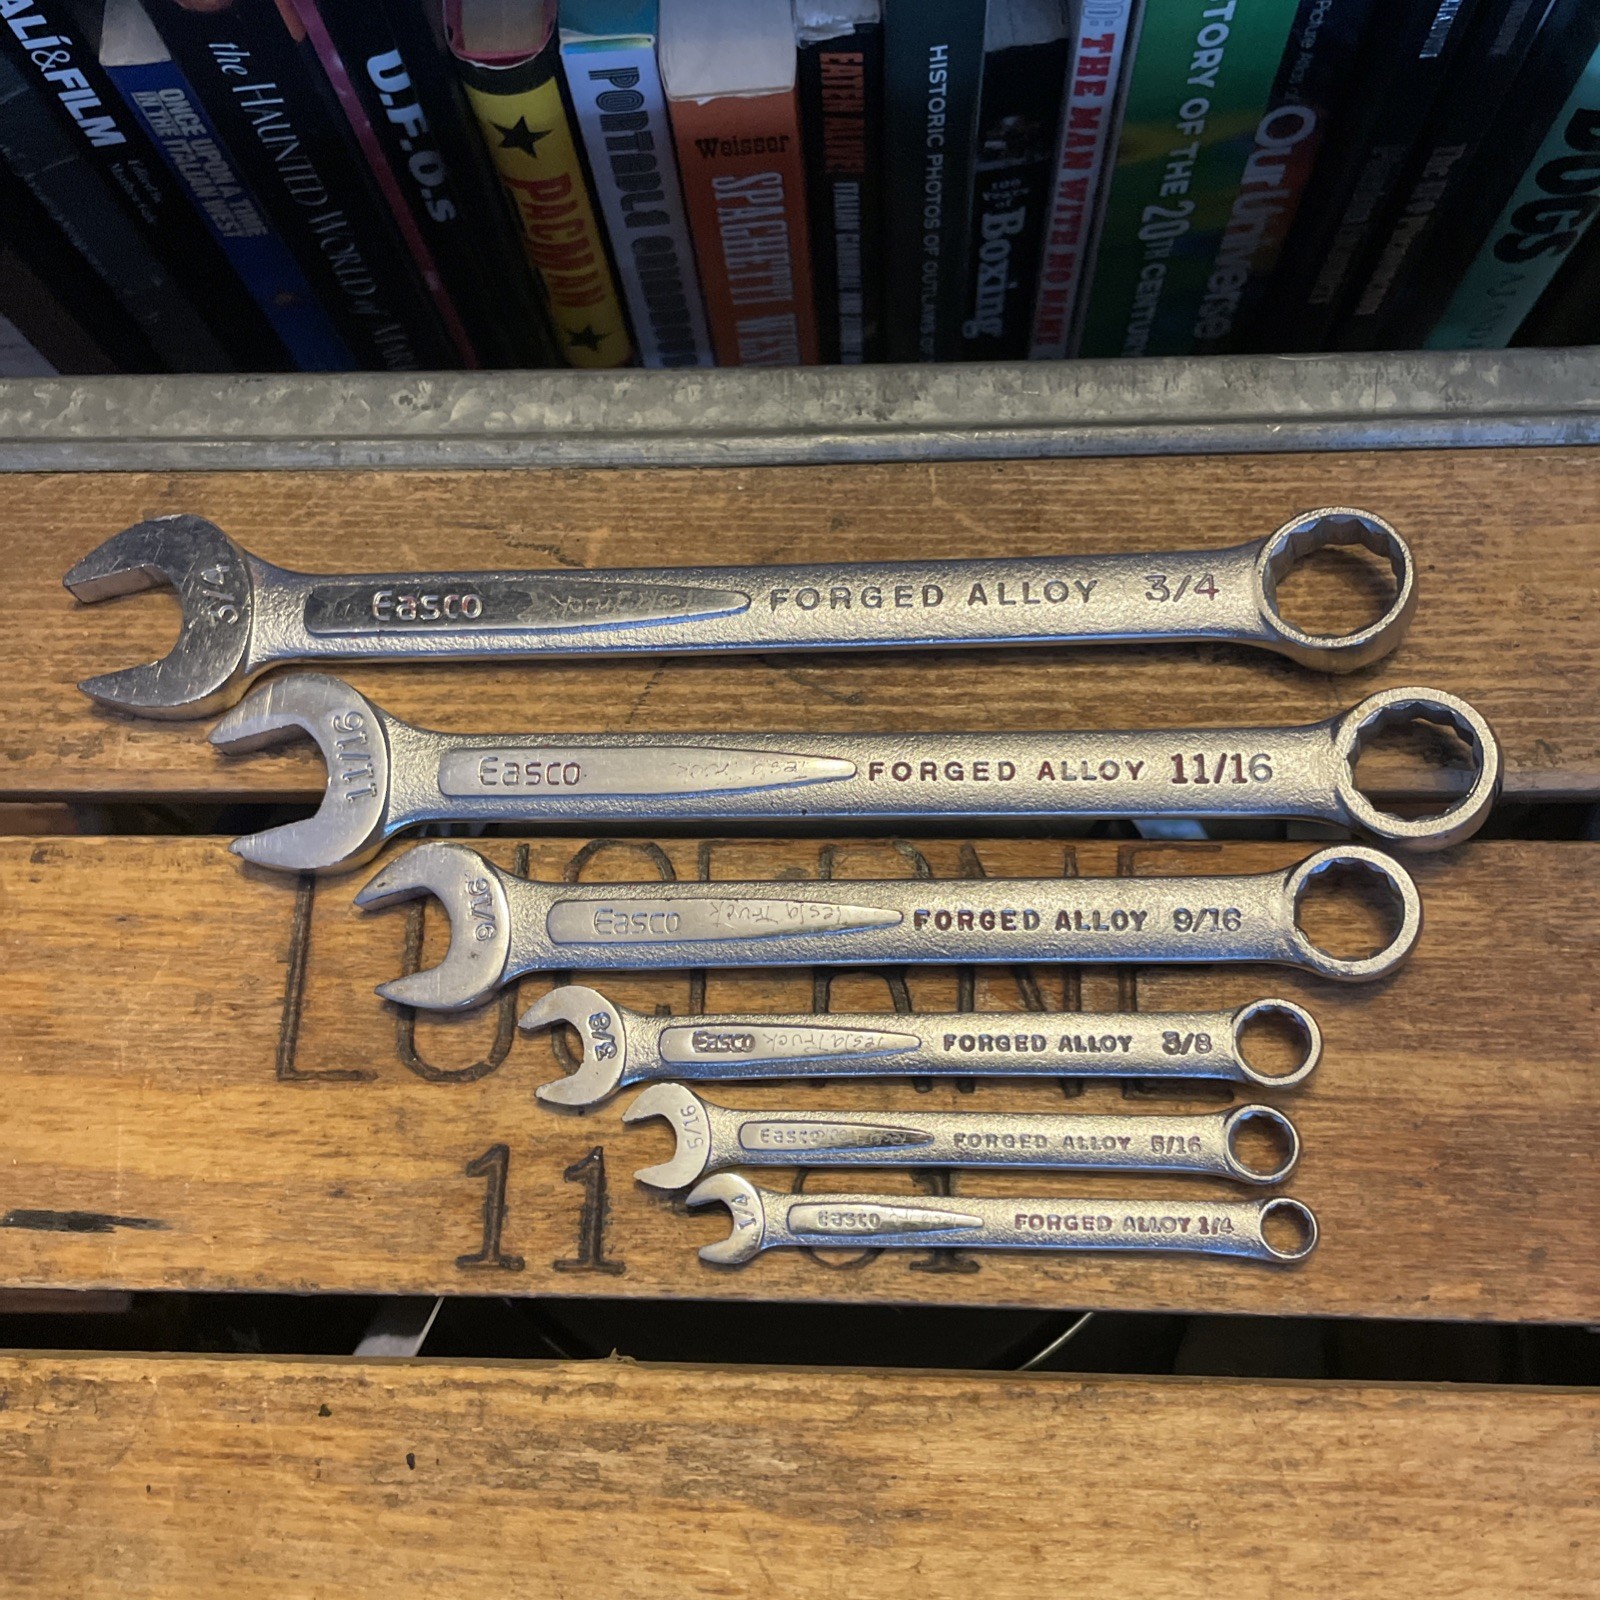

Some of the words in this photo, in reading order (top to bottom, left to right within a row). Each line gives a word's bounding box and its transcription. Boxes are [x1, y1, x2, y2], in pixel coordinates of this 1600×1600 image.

[1077, 33, 1116, 97] THE
[1186, 0, 1238, 89] TORY
[819, 52, 865, 112] EATEN
[926, 44, 949, 149] HISTORIC
[145, 109, 183, 138] THE
[159, 87, 208, 137] ONCE
[191, 138, 239, 187] UPON
[217, 184, 246, 199] A
[1063, 107, 1102, 170] MAN
[1179, 98, 1210, 136] OF
[1242, 104, 1318, 185] Our
[162, 138, 219, 199] ITALIAN
[207, 41, 250, 76] the
[232, 82, 329, 206] HAUNTED
[308, 211, 378, 296] WORLD
[923, 153, 945, 230] PHOTOS
[1158, 143, 1200, 197] THE
[201, 199, 244, 238] WEST
[711, 171, 792, 306] SPAGHETTI
[922, 235, 941, 257] OF
[961, 206, 1027, 340] Boxing
[1047, 253, 1076, 283] NO
[1193, 184, 1292, 339] Universe
[201, 562, 242, 627] 3/4
[371, 590, 484, 622] Easco
[769, 584, 945, 613] FORGED
[966, 578, 1099, 608] ALLOY
[1144, 572, 1221, 604] 3/4
[331, 708, 379, 803] 11/16
[477, 755, 583, 788] Easco
[868, 761, 1016, 783] FORGED
[1036, 759, 1145, 783] ALLOY
[1170, 752, 1273, 785] 11/16
[467, 876, 497, 942] 9/16
[593, 908, 681, 936] Easco
[913, 909, 1041, 932] FORGED
[1054, 908, 1148, 932] ALLOY
[1172, 907, 1242, 934] 9/16
[588, 1011, 617, 1062] 3/8
[692, 1030, 756, 1053] Easco
[943, 1033, 1047, 1053] FORGED
[1057, 1034, 1133, 1053] ALLOY
[1161, 1030, 1213, 1056] 3/8
[680, 1104, 705, 1151] 5/16
[759, 1127, 822, 1145] Easco
[952, 1133, 1048, 1150] FORGED
[1061, 1135, 1131, 1152] ALLOY
[1150, 1134, 1202, 1156] 5/16
[730, 1193, 758, 1231] 1/4
[817, 1210, 881, 1229] Easco
[1014, 1213, 1113, 1232] FORGED
[1122, 1216, 1192, 1234] ALLOY
[1198, 1215, 1235, 1236] 1/4
